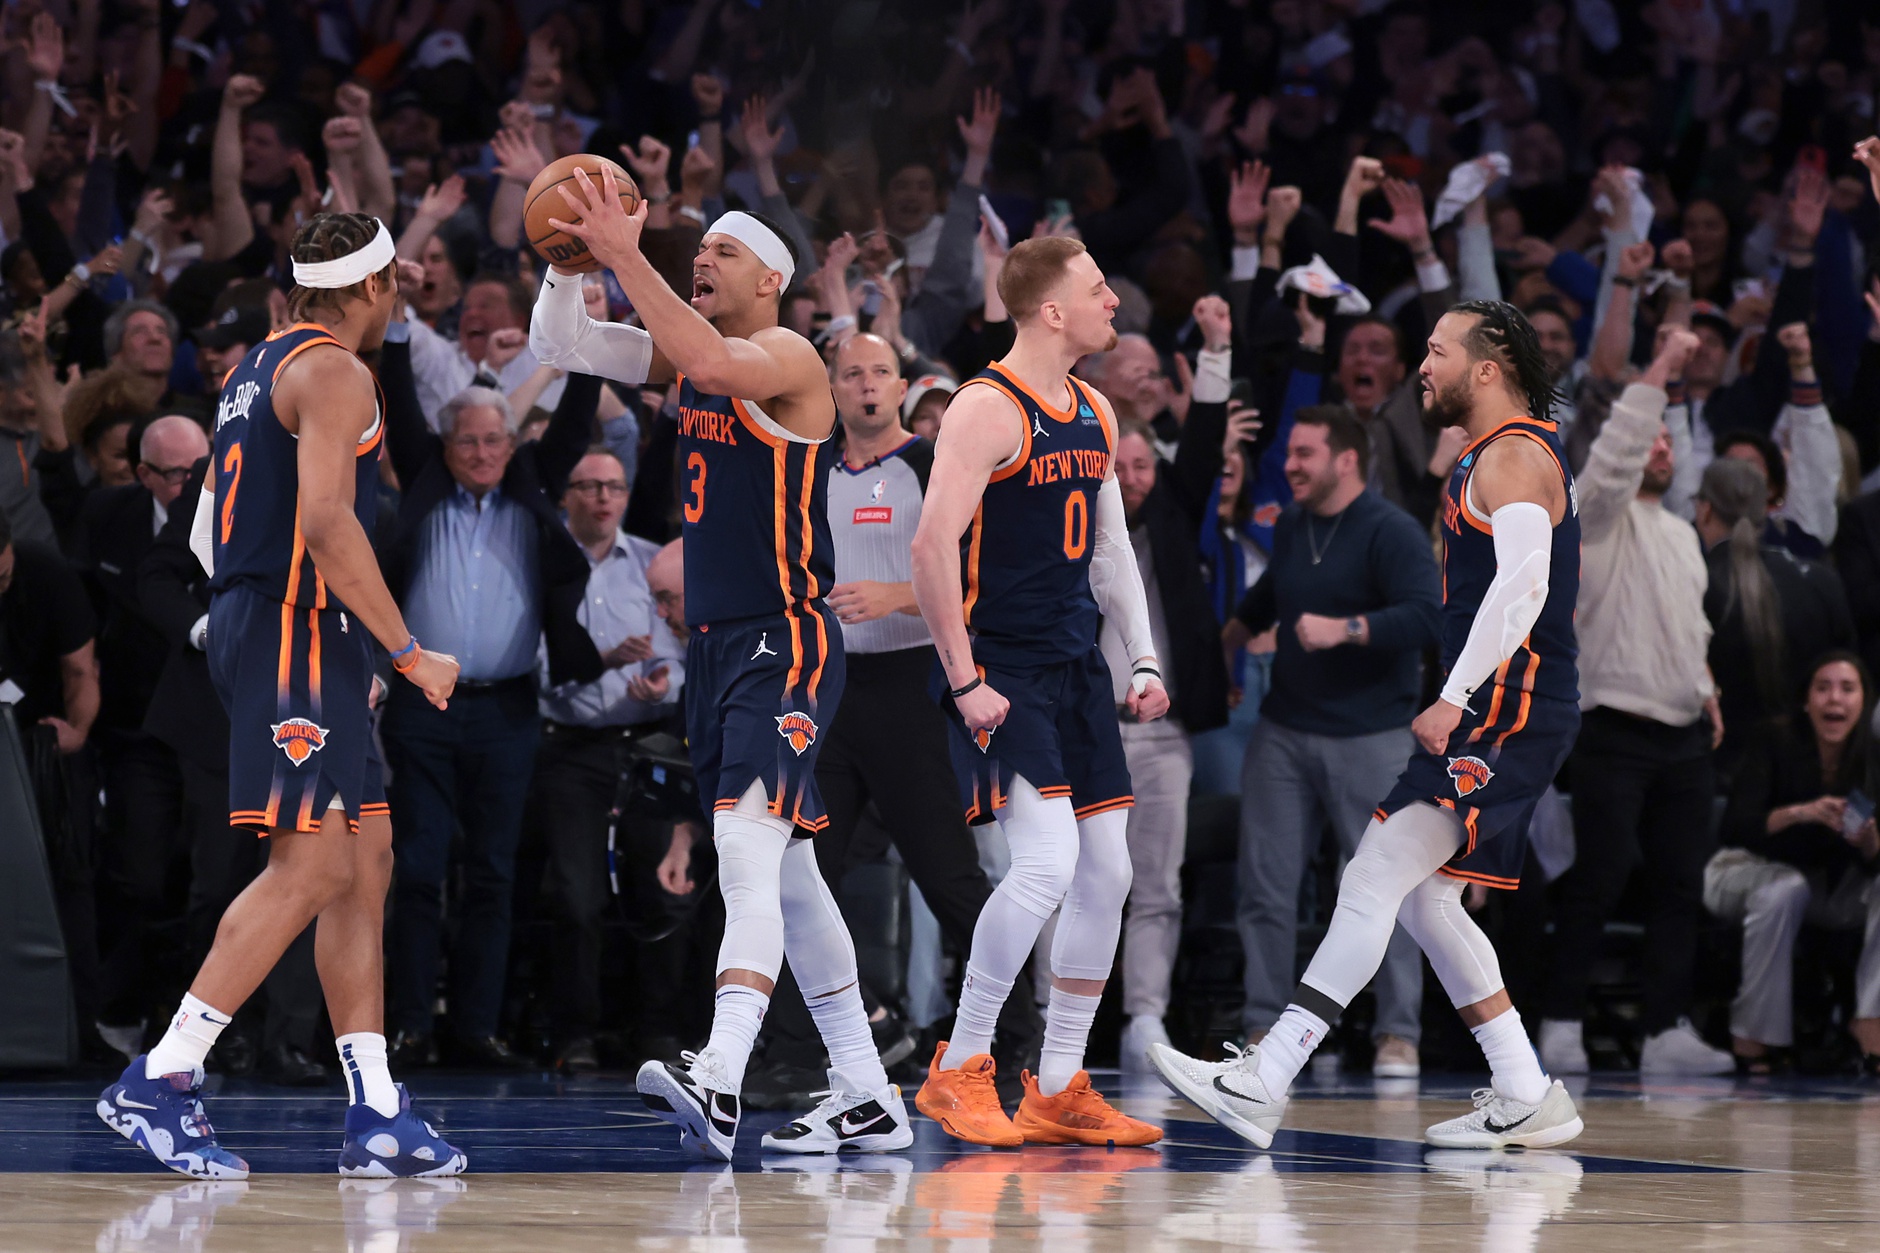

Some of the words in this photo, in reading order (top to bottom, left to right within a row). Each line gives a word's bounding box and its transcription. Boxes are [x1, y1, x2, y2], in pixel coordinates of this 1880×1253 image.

[1027, 450, 1072, 486] NEW
[221, 442, 243, 545] 2
[684, 452, 707, 523] 3
[855, 511, 889, 521] Emirates
[1063, 490, 1087, 560] 0
[275, 723, 323, 745] KNICKS
[780, 715, 815, 739] KNICKS
[1449, 758, 1488, 785] KNICKS
